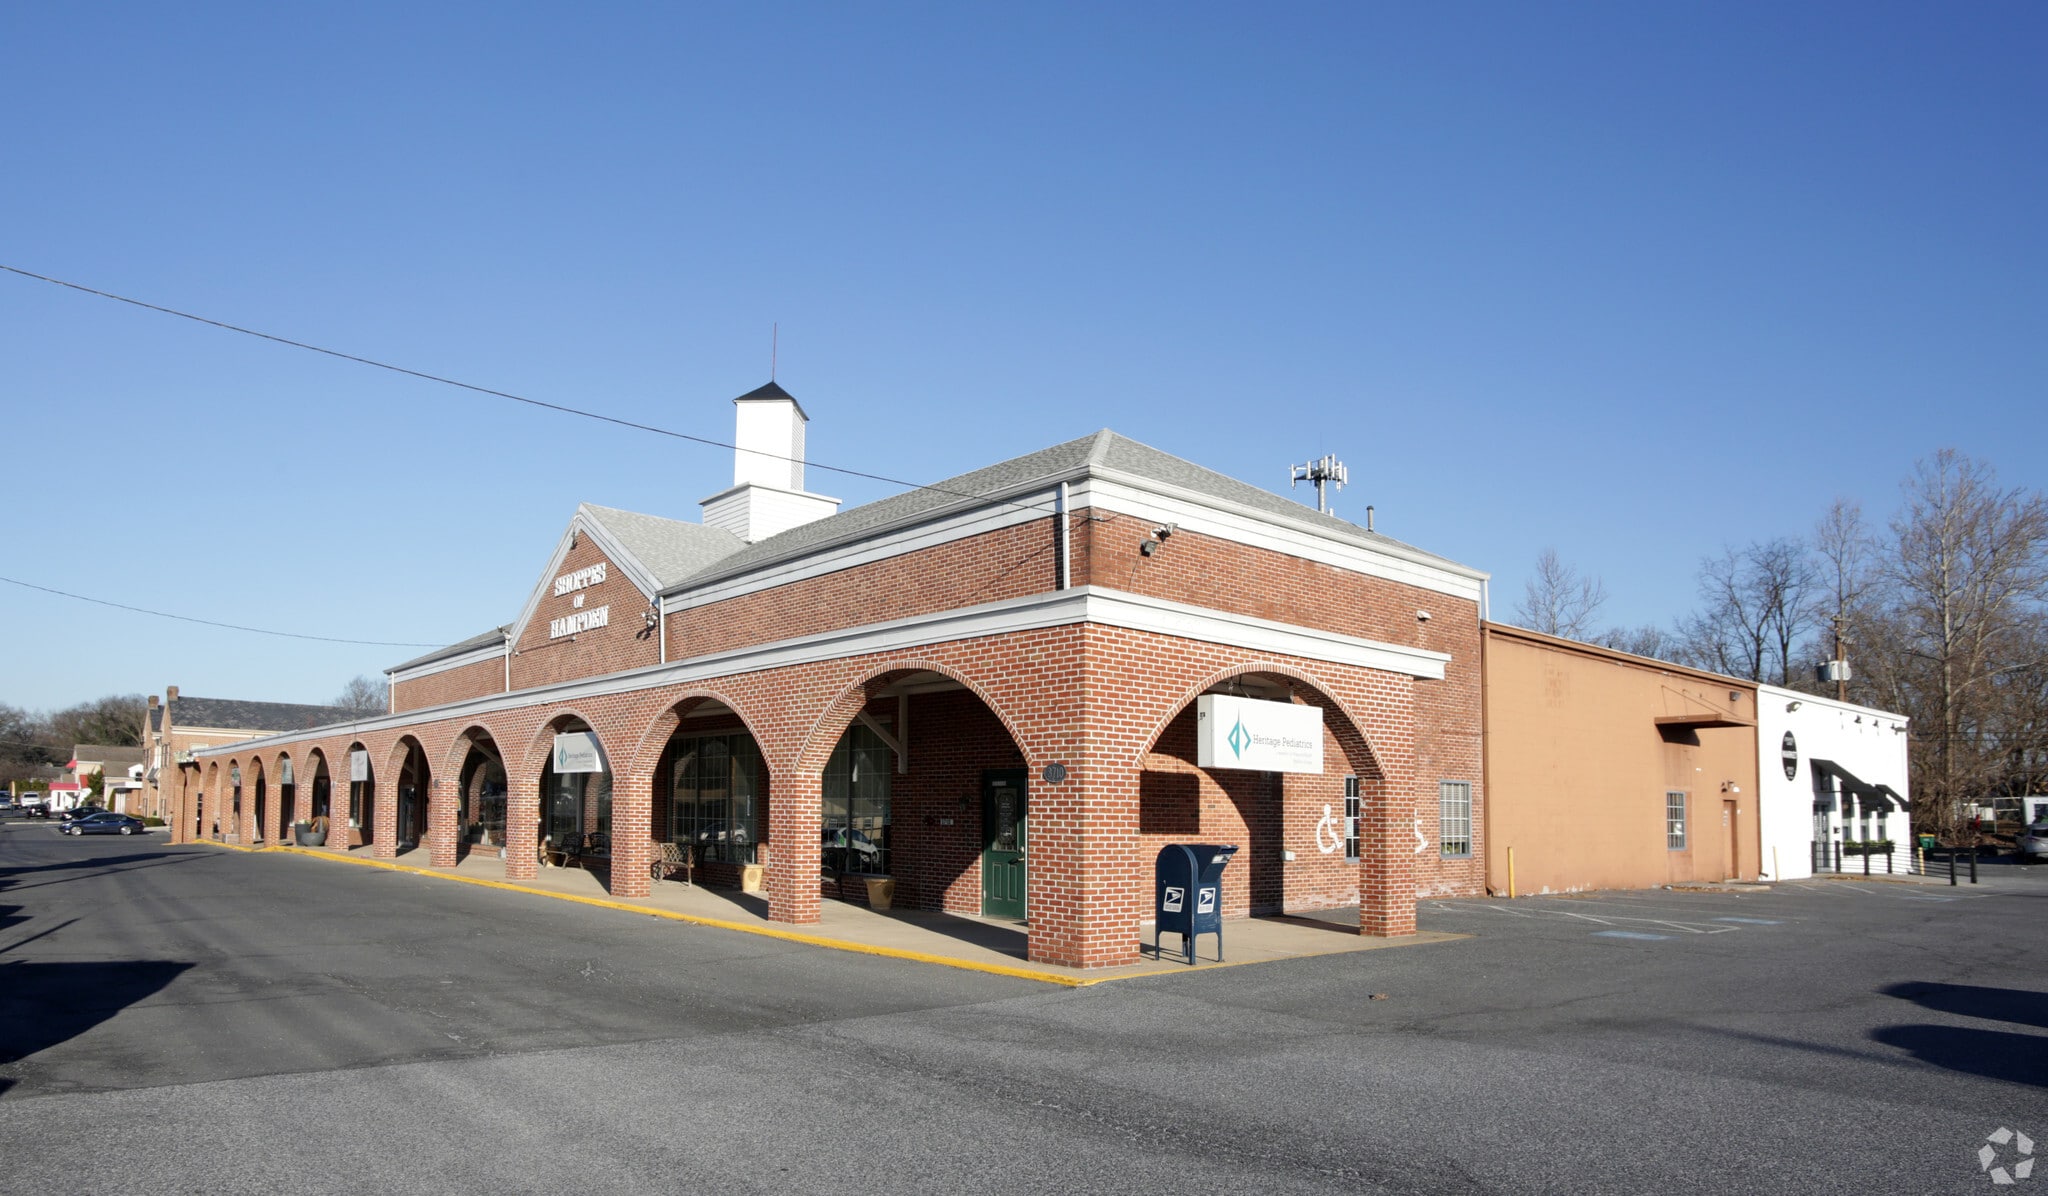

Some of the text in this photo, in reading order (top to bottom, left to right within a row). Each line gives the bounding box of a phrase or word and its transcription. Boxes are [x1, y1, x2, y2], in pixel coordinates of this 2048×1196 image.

[554, 562, 607, 597] SHOPPES
[550, 605, 609, 639] HAMPDEN
[1253, 734, 1312, 749] Heritage Pediatrics
